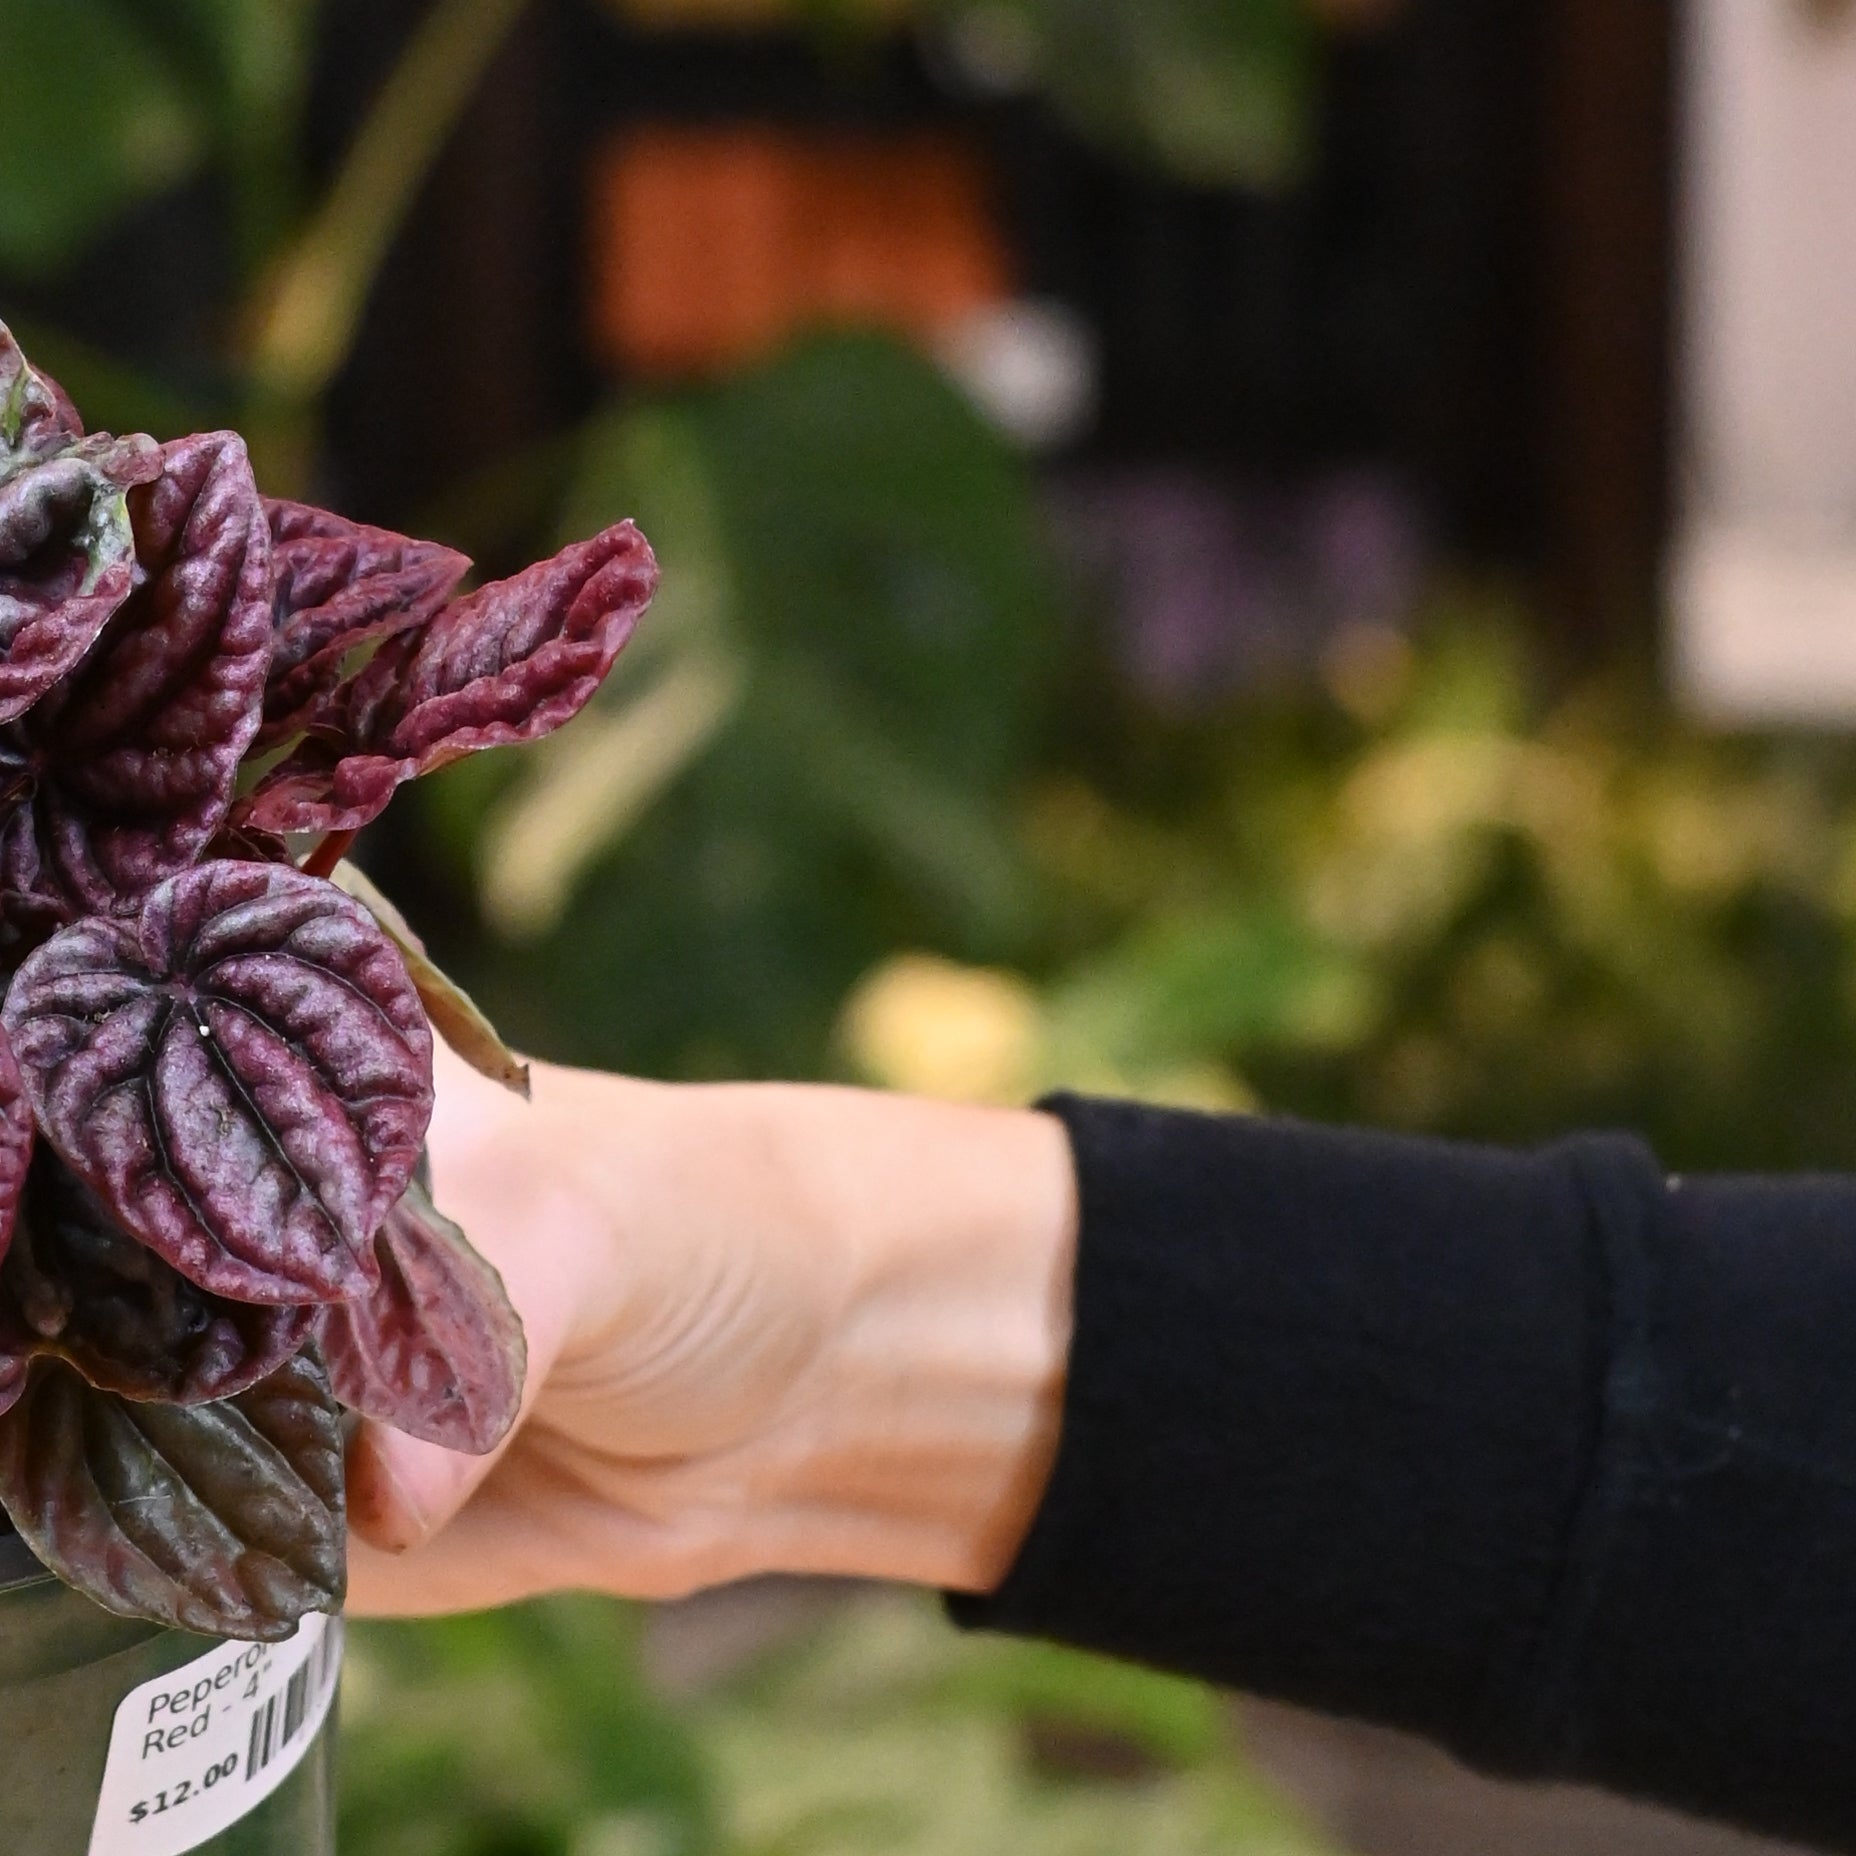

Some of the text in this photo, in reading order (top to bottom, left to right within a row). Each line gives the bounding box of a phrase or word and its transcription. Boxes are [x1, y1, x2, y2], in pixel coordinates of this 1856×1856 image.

[141, 1703, 211, 1760] Red
[242, 1659, 273, 1699] 4"
[129, 1752, 239, 1825] $12.00
